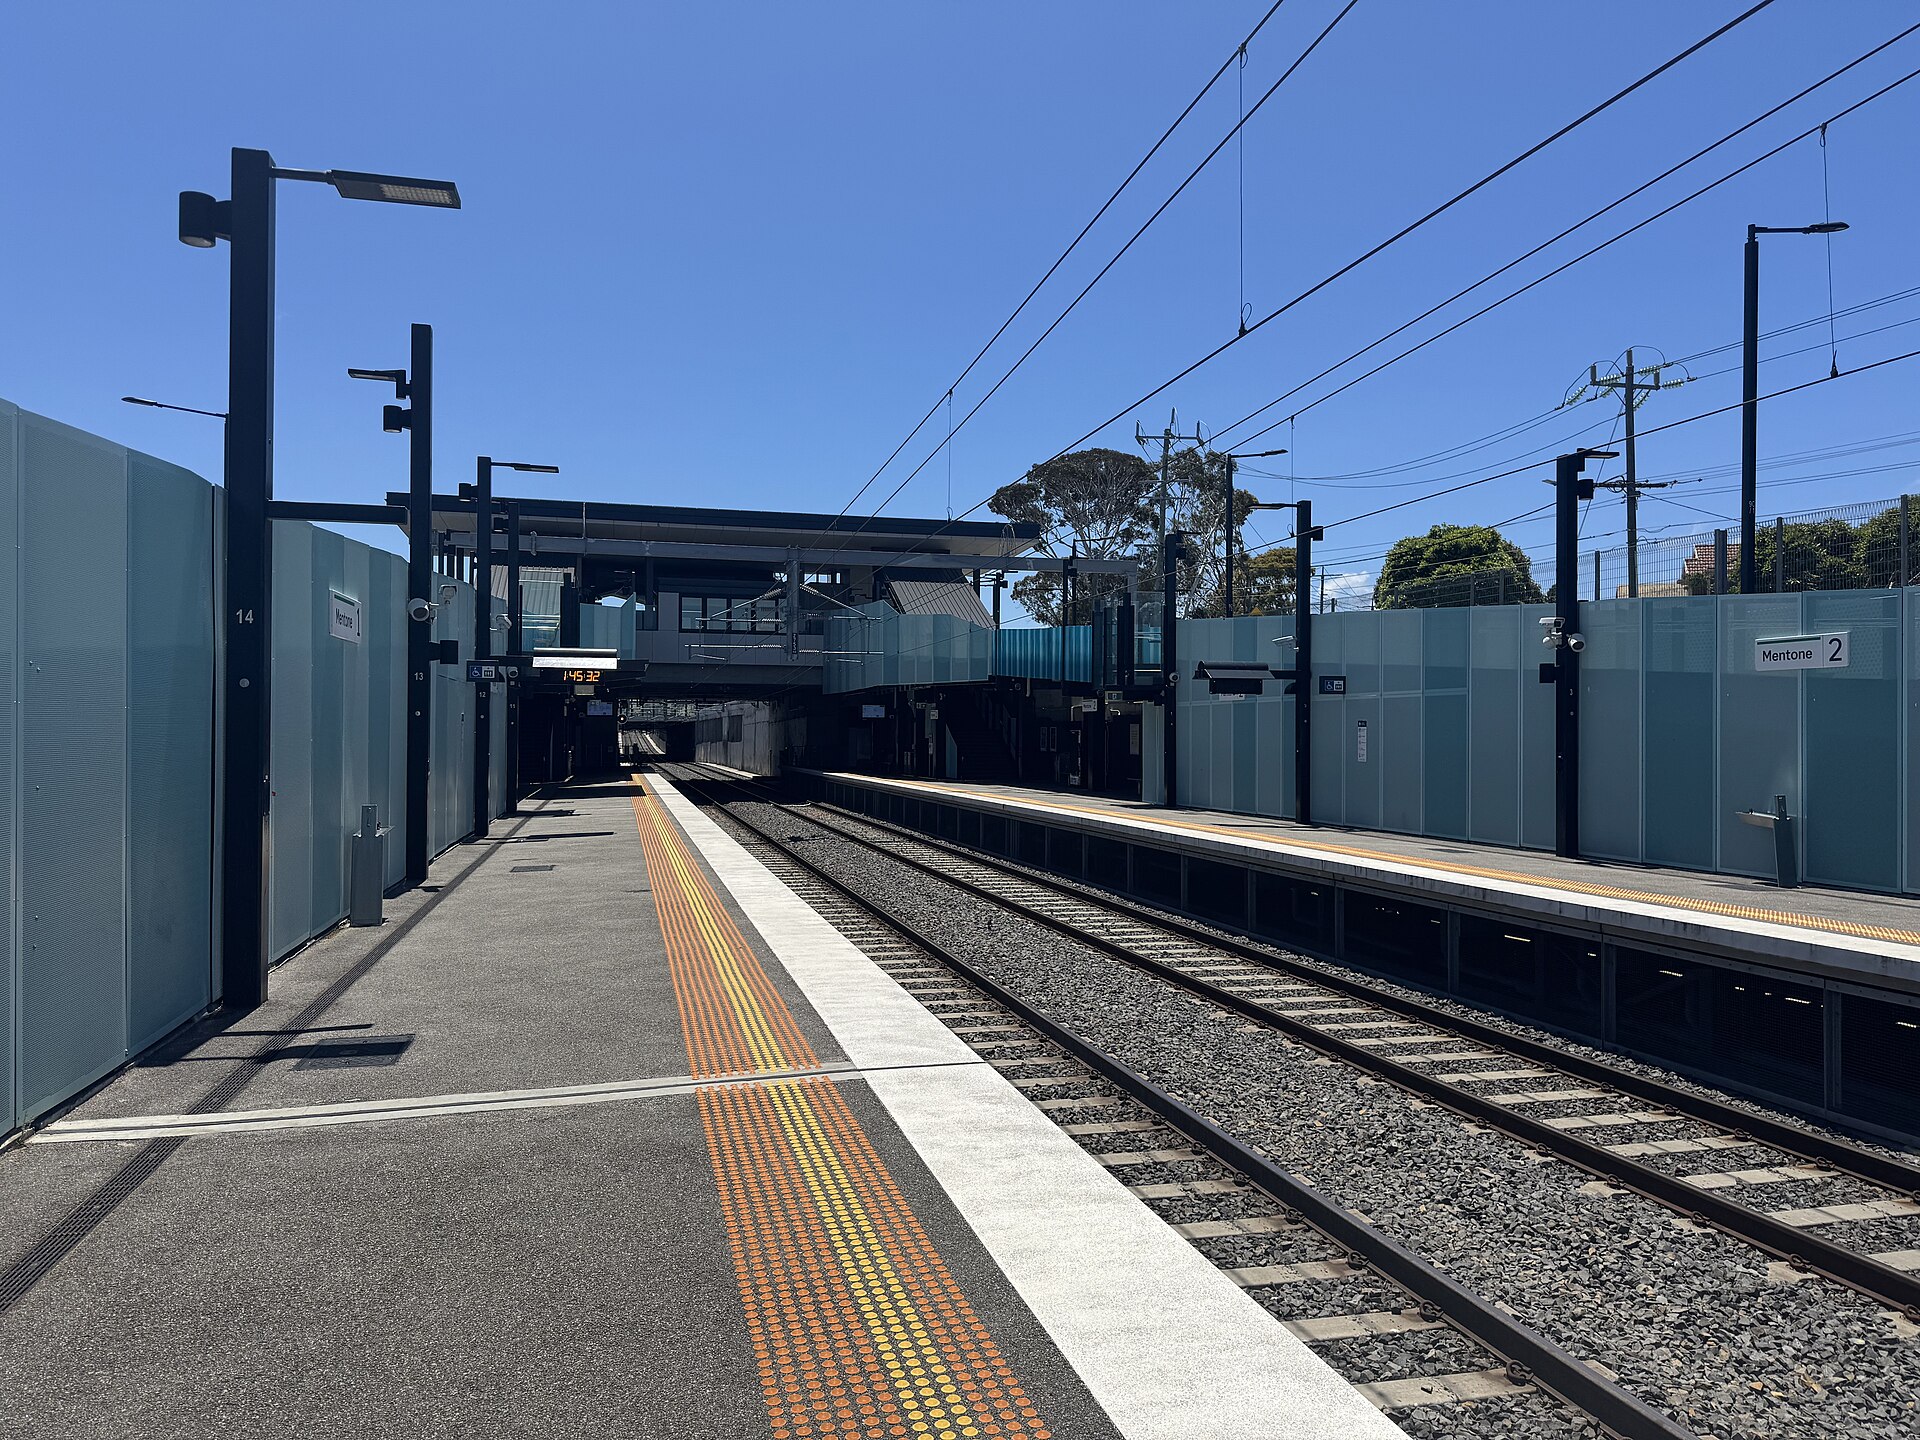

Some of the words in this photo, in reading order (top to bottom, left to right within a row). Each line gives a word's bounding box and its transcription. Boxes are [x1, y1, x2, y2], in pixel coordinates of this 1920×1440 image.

[235, 608, 254, 624] 14
[356, 607, 361, 637] 1
[1762, 649, 1812, 662] Mentone
[1828, 637, 1842, 662] 2
[414, 671, 424, 681] 13
[563, 670, 600, 682] 1:45:32
